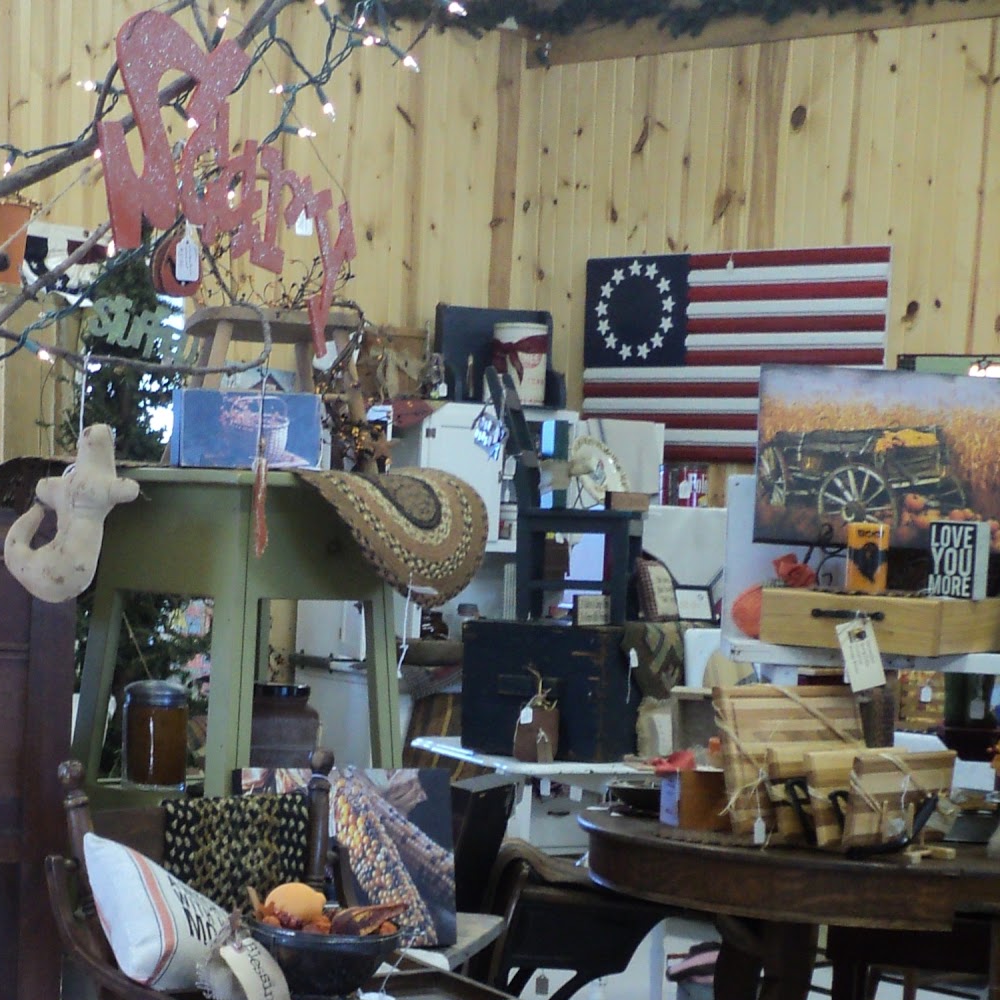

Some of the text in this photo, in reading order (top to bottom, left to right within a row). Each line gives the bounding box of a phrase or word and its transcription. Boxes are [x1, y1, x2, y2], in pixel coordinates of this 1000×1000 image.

[930, 524, 975, 549] LOVE
[931, 547, 972, 577] YOU
[928, 574, 971, 597] MORE
